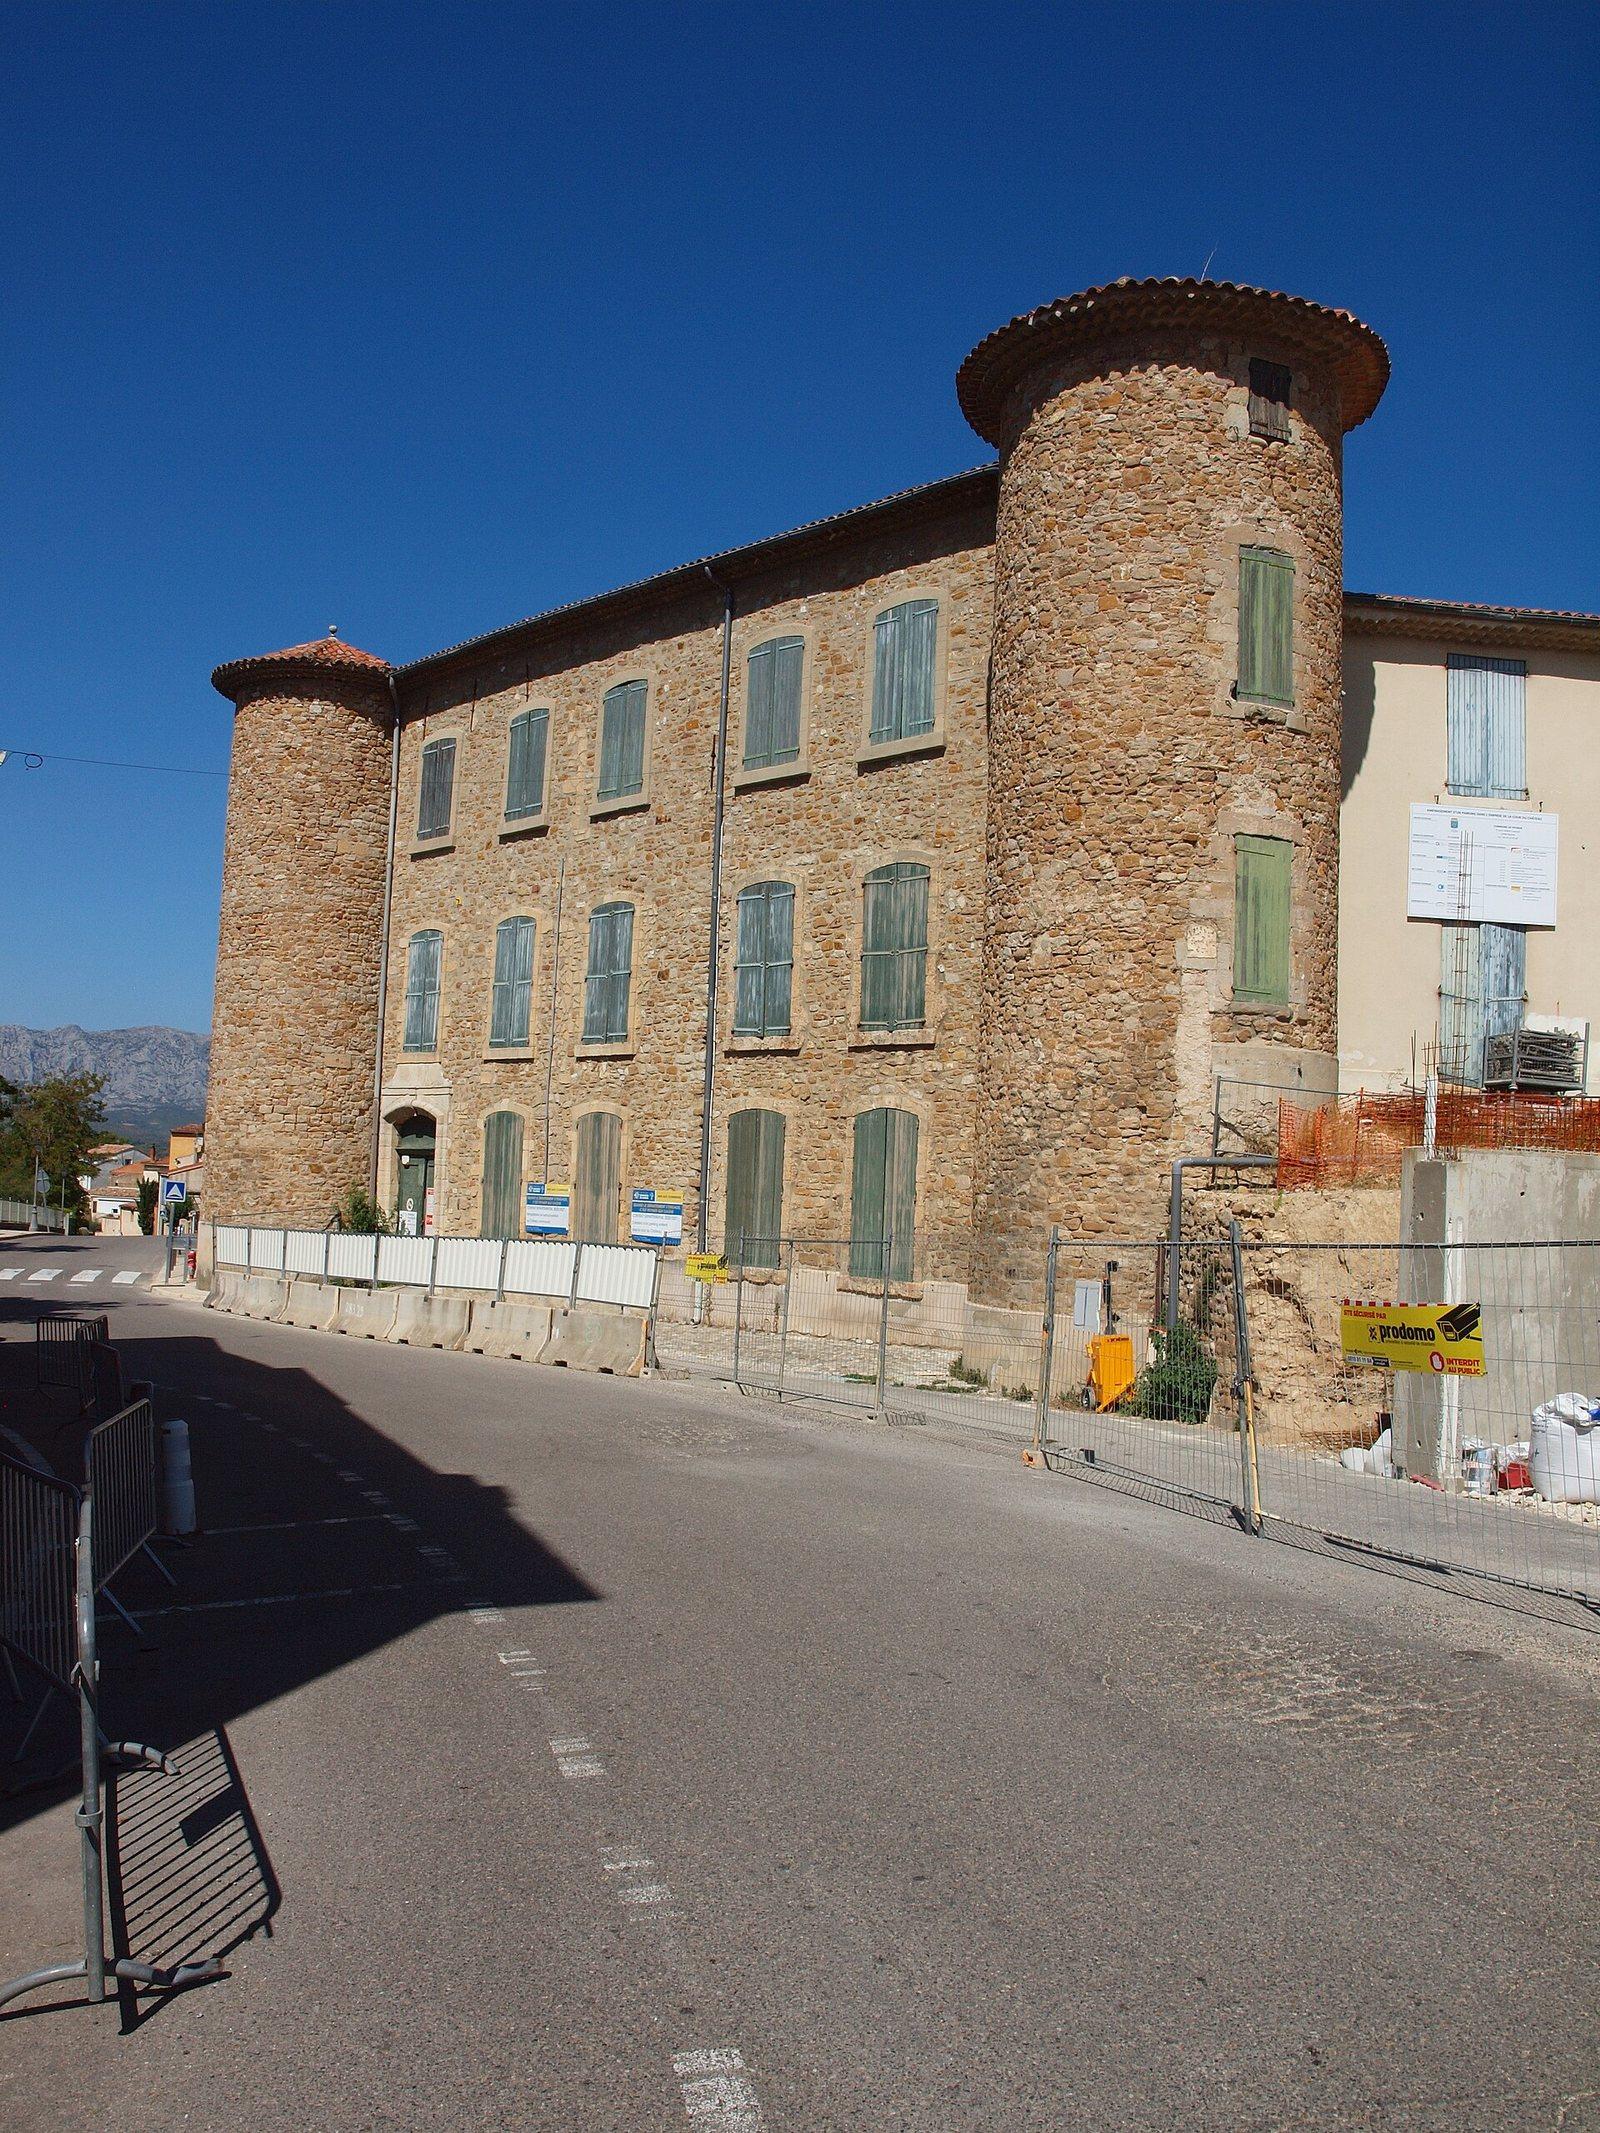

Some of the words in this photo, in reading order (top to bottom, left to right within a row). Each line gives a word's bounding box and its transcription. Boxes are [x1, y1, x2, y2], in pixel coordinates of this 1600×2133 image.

[1376, 1312, 1387, 1320] PAR
[1380, 1322, 1435, 1343] prodomo
[1446, 1358, 1480, 1367] INTERDIT
[1457, 1367, 1481, 1375] PUBLIC
